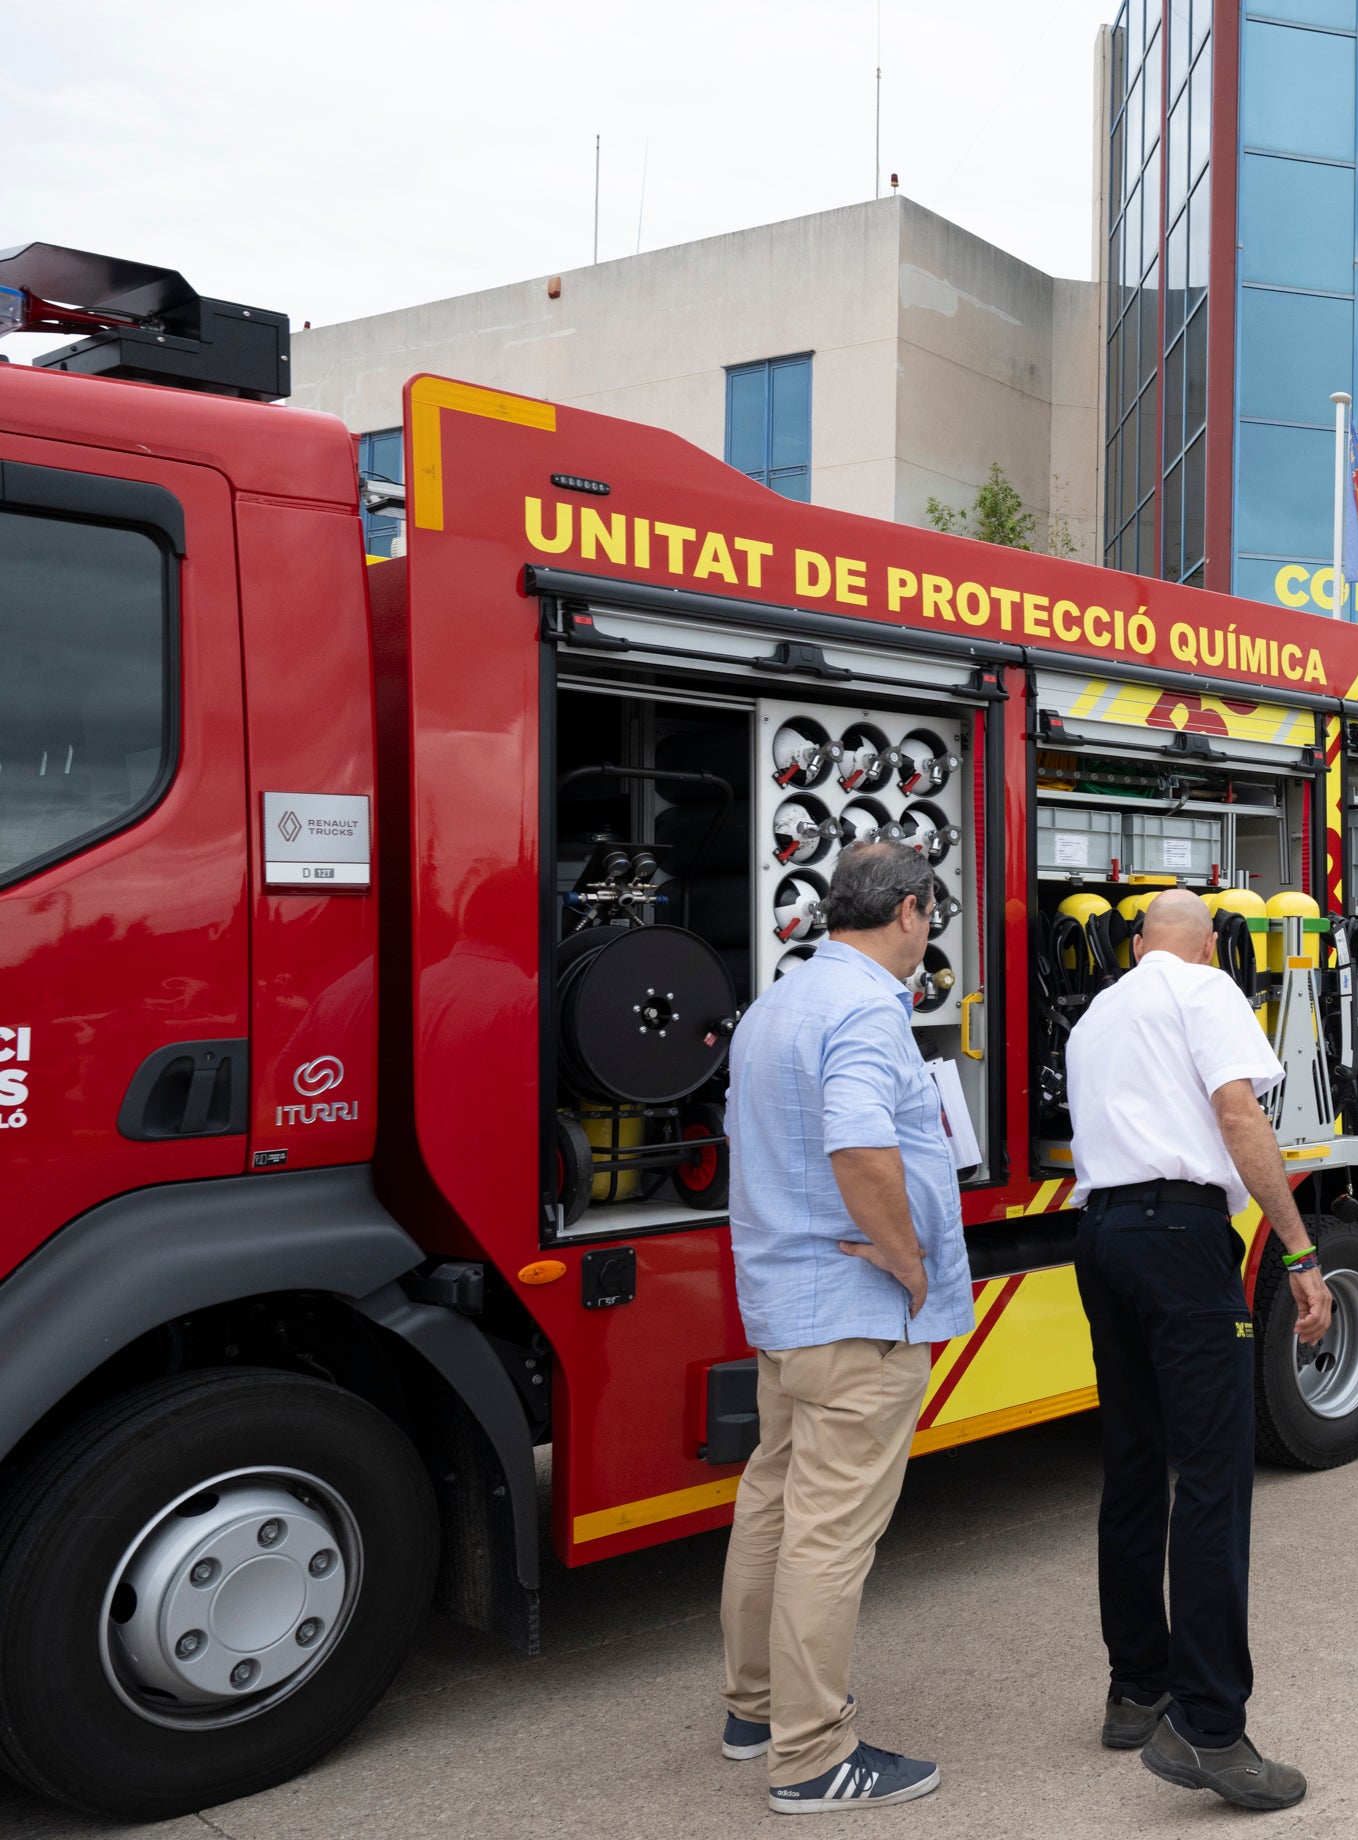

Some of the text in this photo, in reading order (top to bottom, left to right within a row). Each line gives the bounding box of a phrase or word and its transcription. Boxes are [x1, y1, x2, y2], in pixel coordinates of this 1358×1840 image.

[524, 496, 1328, 686] UNITAT DE PROTECCIÓ QUÍMICA
[307, 819, 359, 828] RENAULT
[309, 828, 354, 837] TRUCKS
[302, 867, 333, 878] D 12T
[275, 1100, 358, 1126] ITURRI
[777, 1789, 800, 1798] adidas
